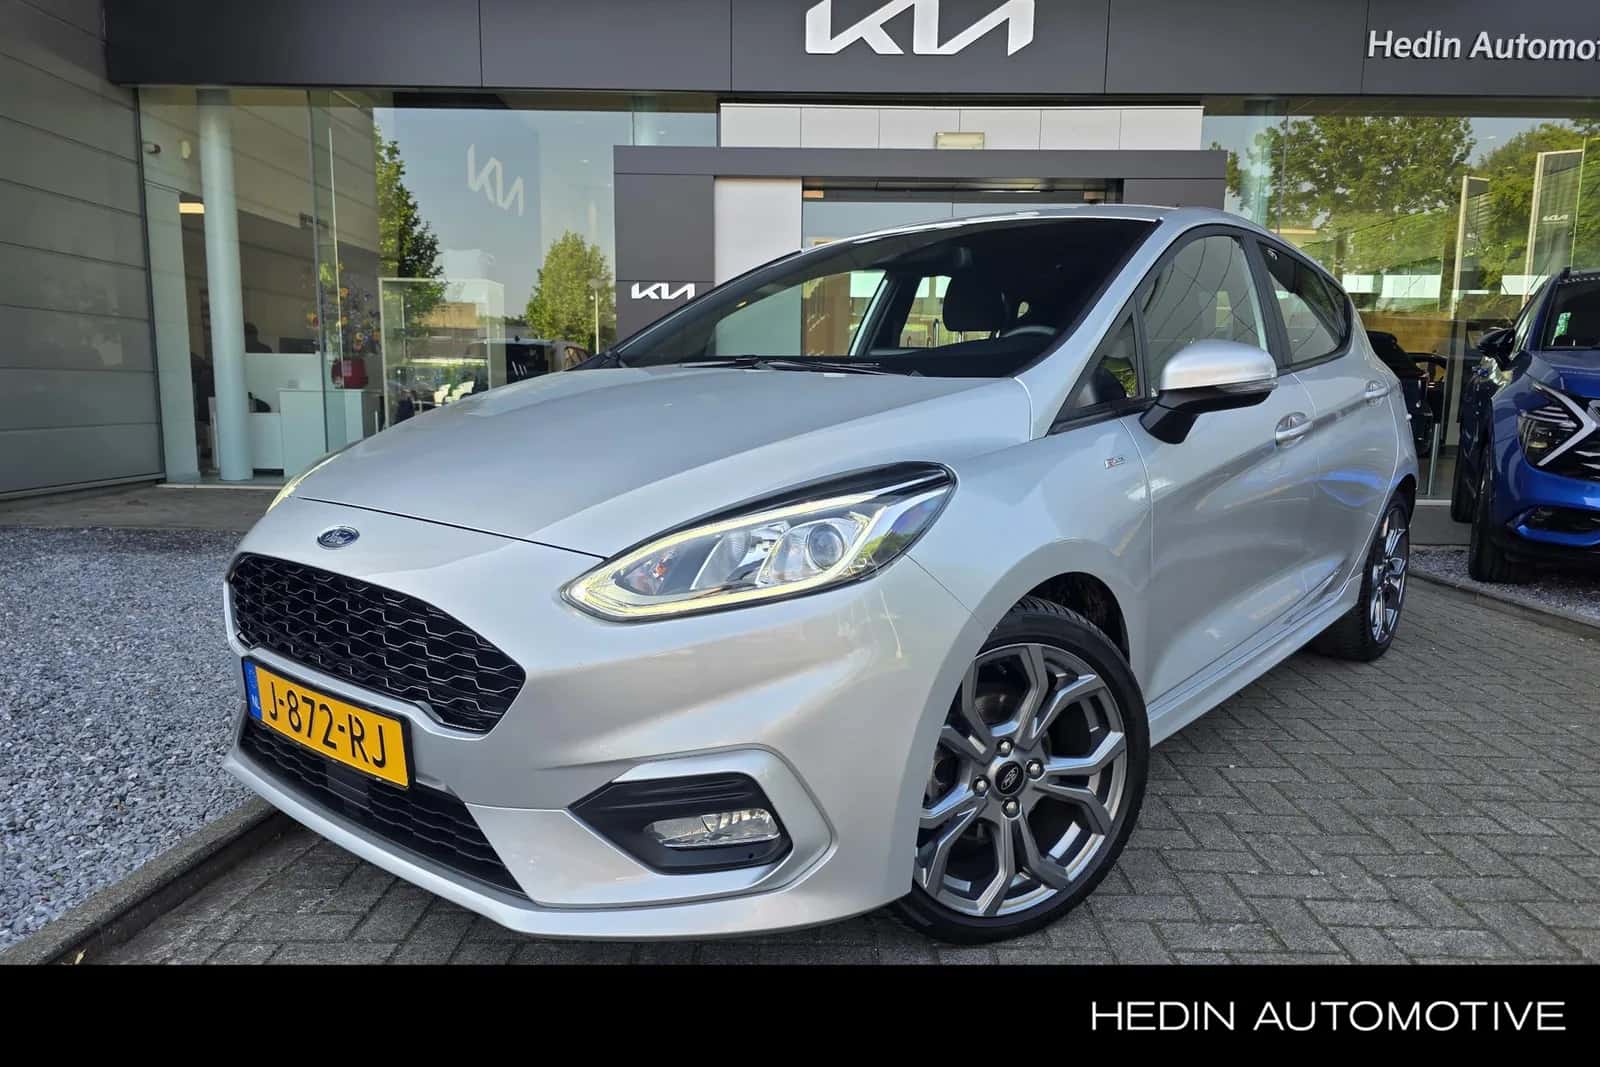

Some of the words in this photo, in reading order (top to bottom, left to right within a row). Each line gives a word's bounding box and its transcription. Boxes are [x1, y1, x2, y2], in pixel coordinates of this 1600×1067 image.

[805, 0, 1035, 56] KIA
[1367, 30, 1461, 58] Hedin
[1469, 31, 1600, 60] Automo
[631, 282, 696, 300] KIA
[269, 681, 387, 769] J-872-RJ
